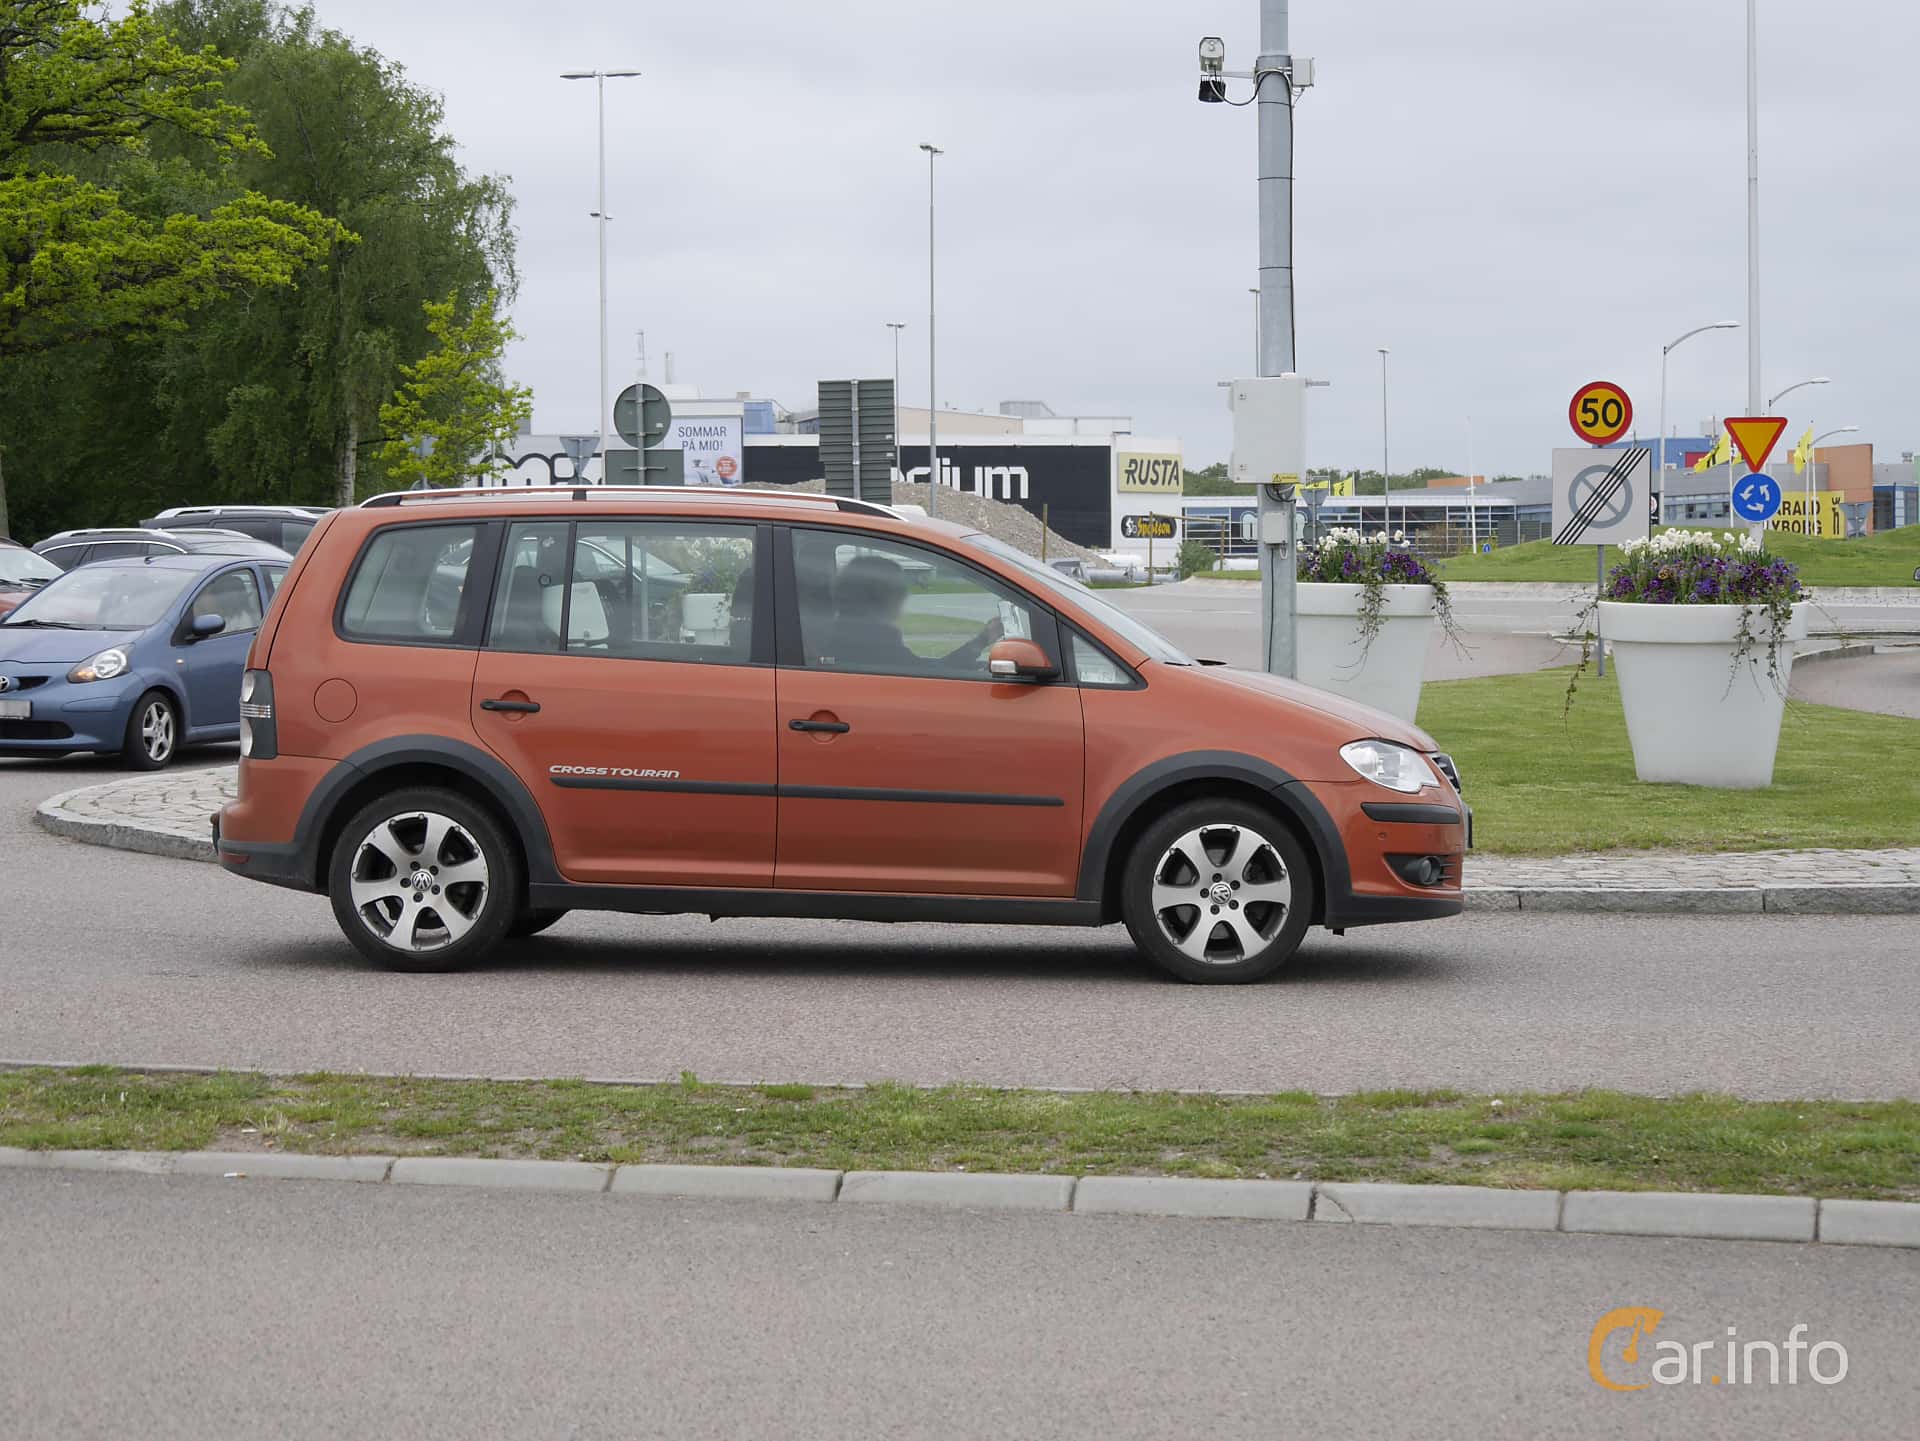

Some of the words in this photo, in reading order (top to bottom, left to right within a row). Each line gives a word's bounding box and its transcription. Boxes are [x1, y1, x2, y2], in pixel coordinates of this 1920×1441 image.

[1581, 398, 1623, 429] 50
[678, 426, 727, 438] SOMMAR
[699, 439, 723, 451] MIO!
[890, 457, 1029, 499] dium
[1125, 458, 1180, 487] RUSTA
[1777, 500, 1821, 516] RALD
